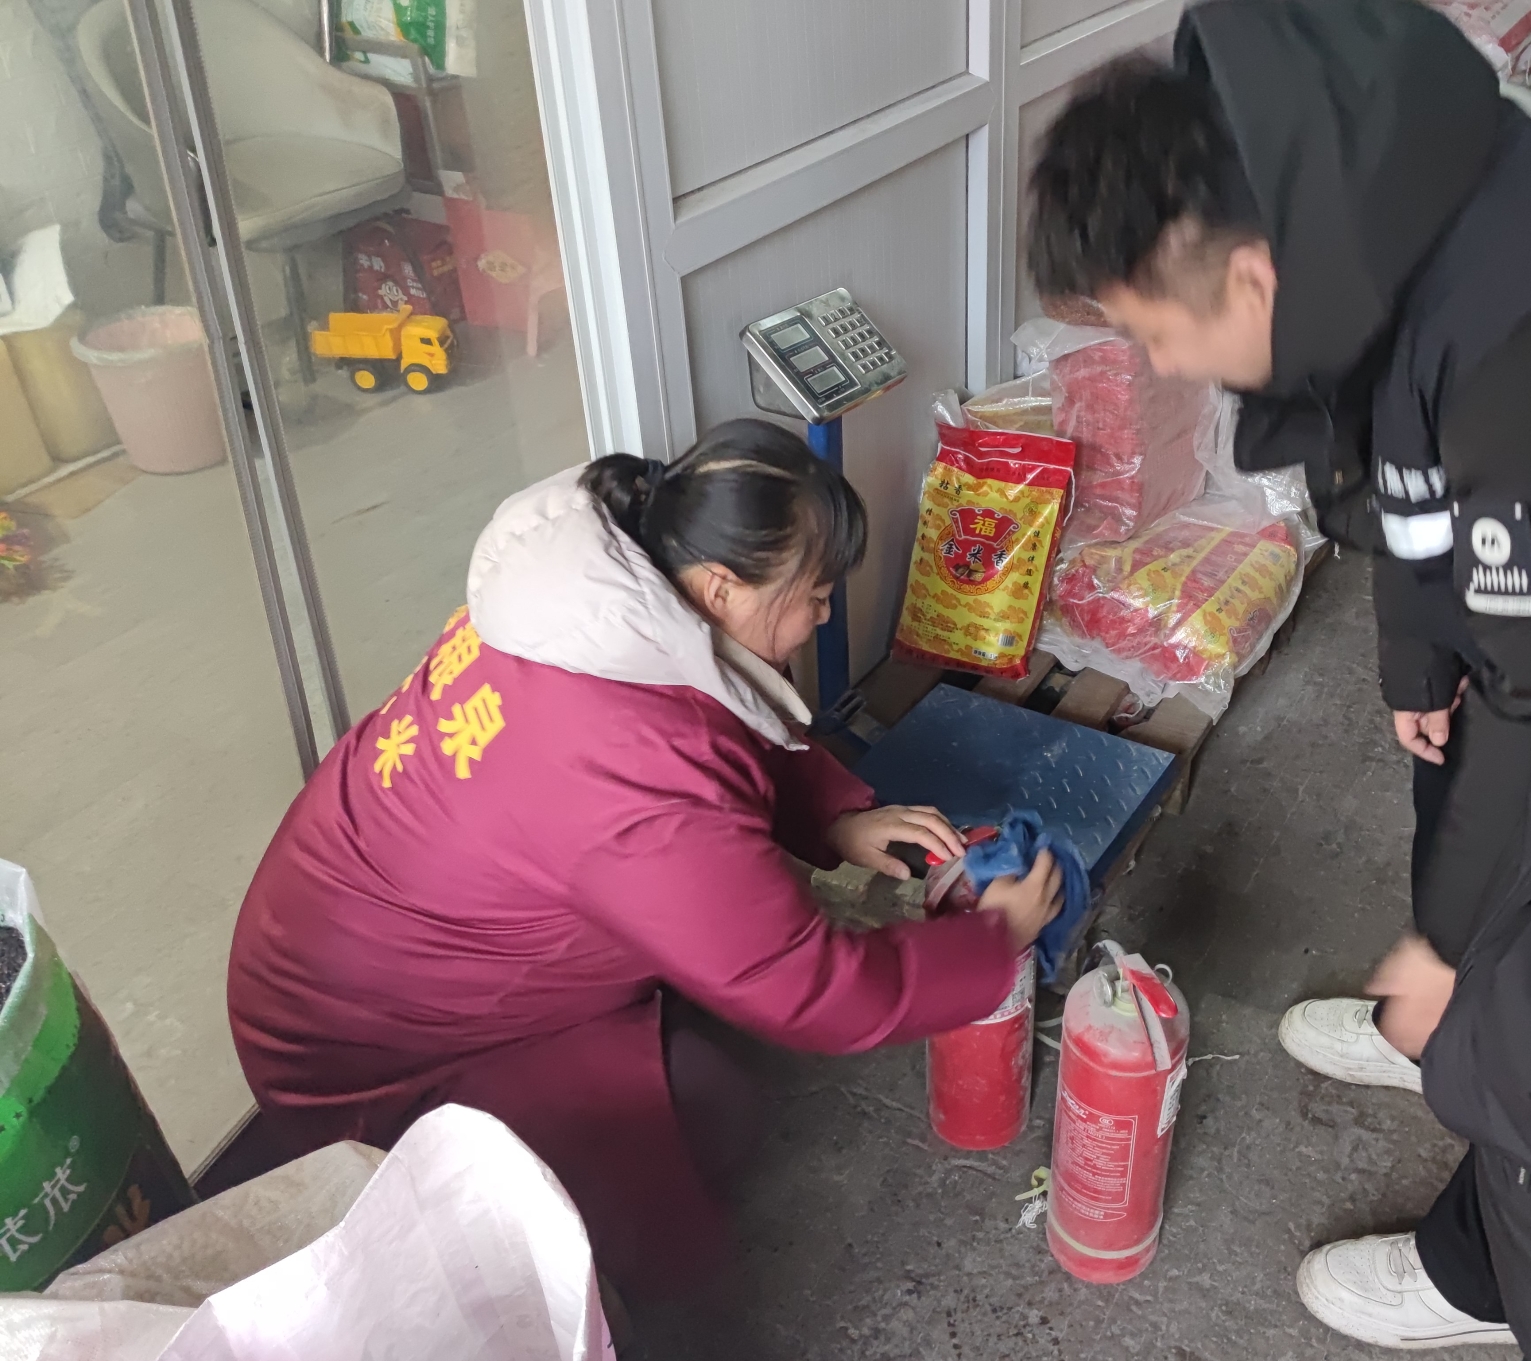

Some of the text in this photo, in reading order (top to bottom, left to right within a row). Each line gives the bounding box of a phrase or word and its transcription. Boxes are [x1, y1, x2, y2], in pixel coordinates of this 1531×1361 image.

[970, 515, 999, 538] 福
[939, 539, 1008, 570] 金米香
